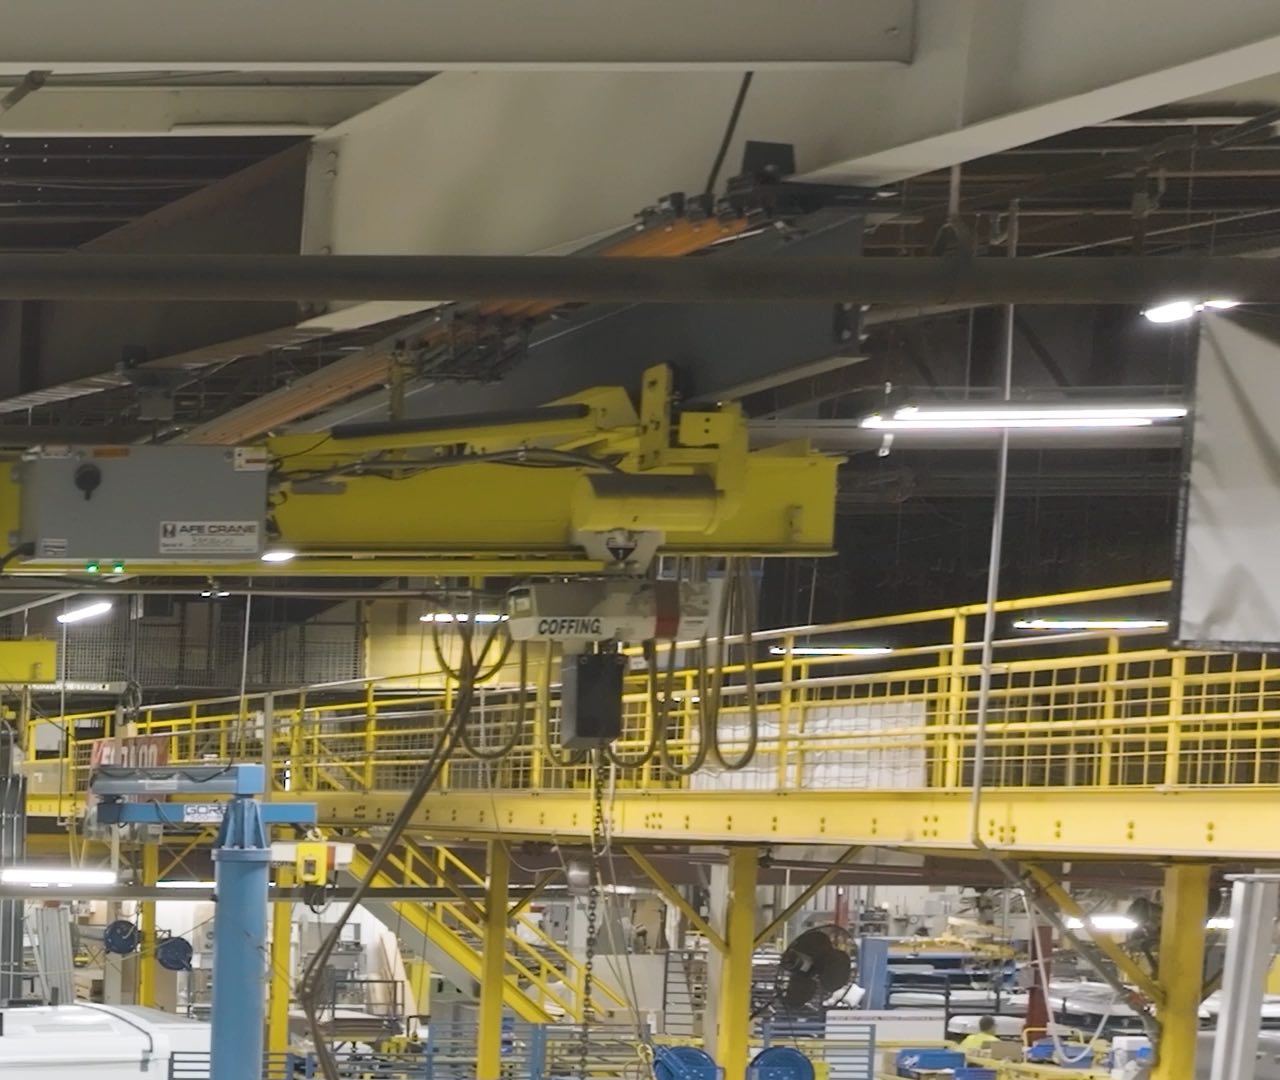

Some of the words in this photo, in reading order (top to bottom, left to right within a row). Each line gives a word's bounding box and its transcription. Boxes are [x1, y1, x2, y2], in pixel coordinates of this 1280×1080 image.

[179, 525, 205, 533] AFE
[208, 525, 257, 533] CRANE
[538, 617, 601, 635] COFFING
